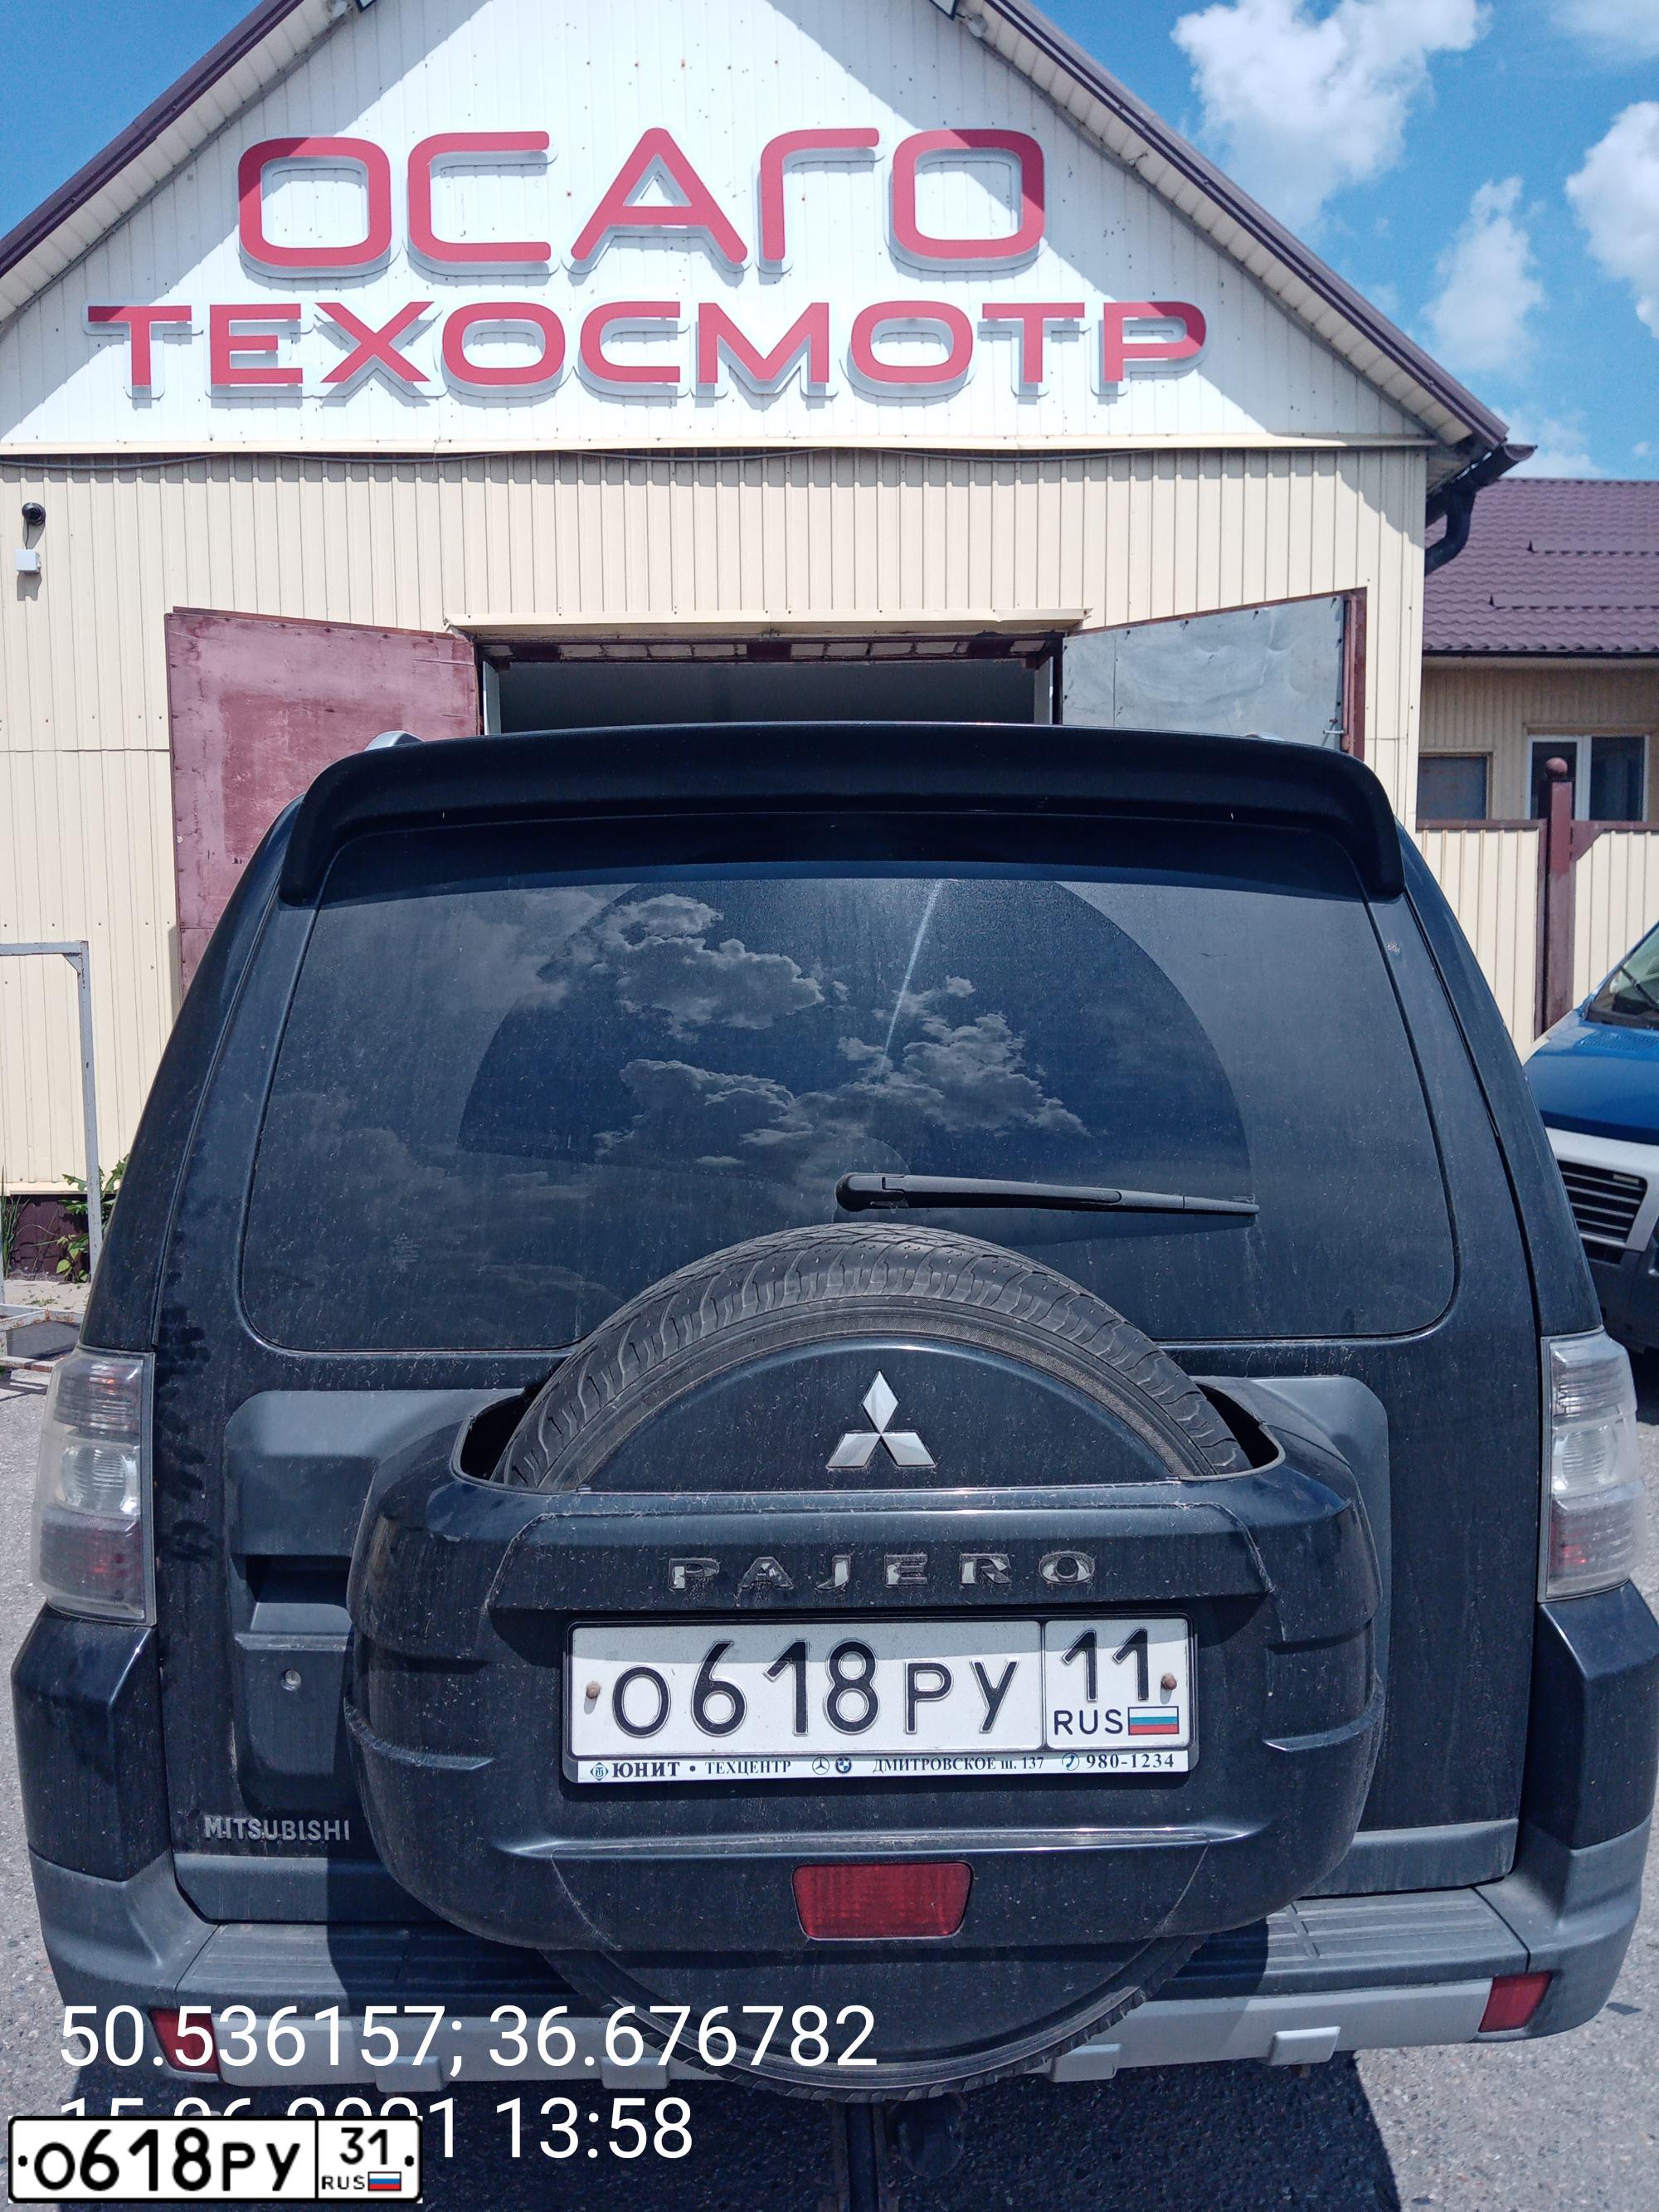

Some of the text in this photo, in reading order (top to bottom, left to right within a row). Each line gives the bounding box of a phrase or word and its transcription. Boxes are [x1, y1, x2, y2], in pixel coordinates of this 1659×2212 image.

[238, 127, 1045, 270] ОСАГО
[87, 300, 1208, 393] ТЕХОСМОТР
[667, 1550, 1095, 1591] PAJERO
[1061, 1625, 1149, 1702] 11
[1053, 1708, 1124, 1736] RUS
[611, 1761, 680, 1779] ЮНИТ
[704, 1760, 792, 1776] ТЕХЦЕНТР
[872, 1756, 997, 1774] ДМИТРОВСКОЕ
[1022, 1756, 1045, 1770] 137
[1085, 1752, 1175, 1770] 980-1234
[204, 1816, 351, 1841] MITSUBISHI
